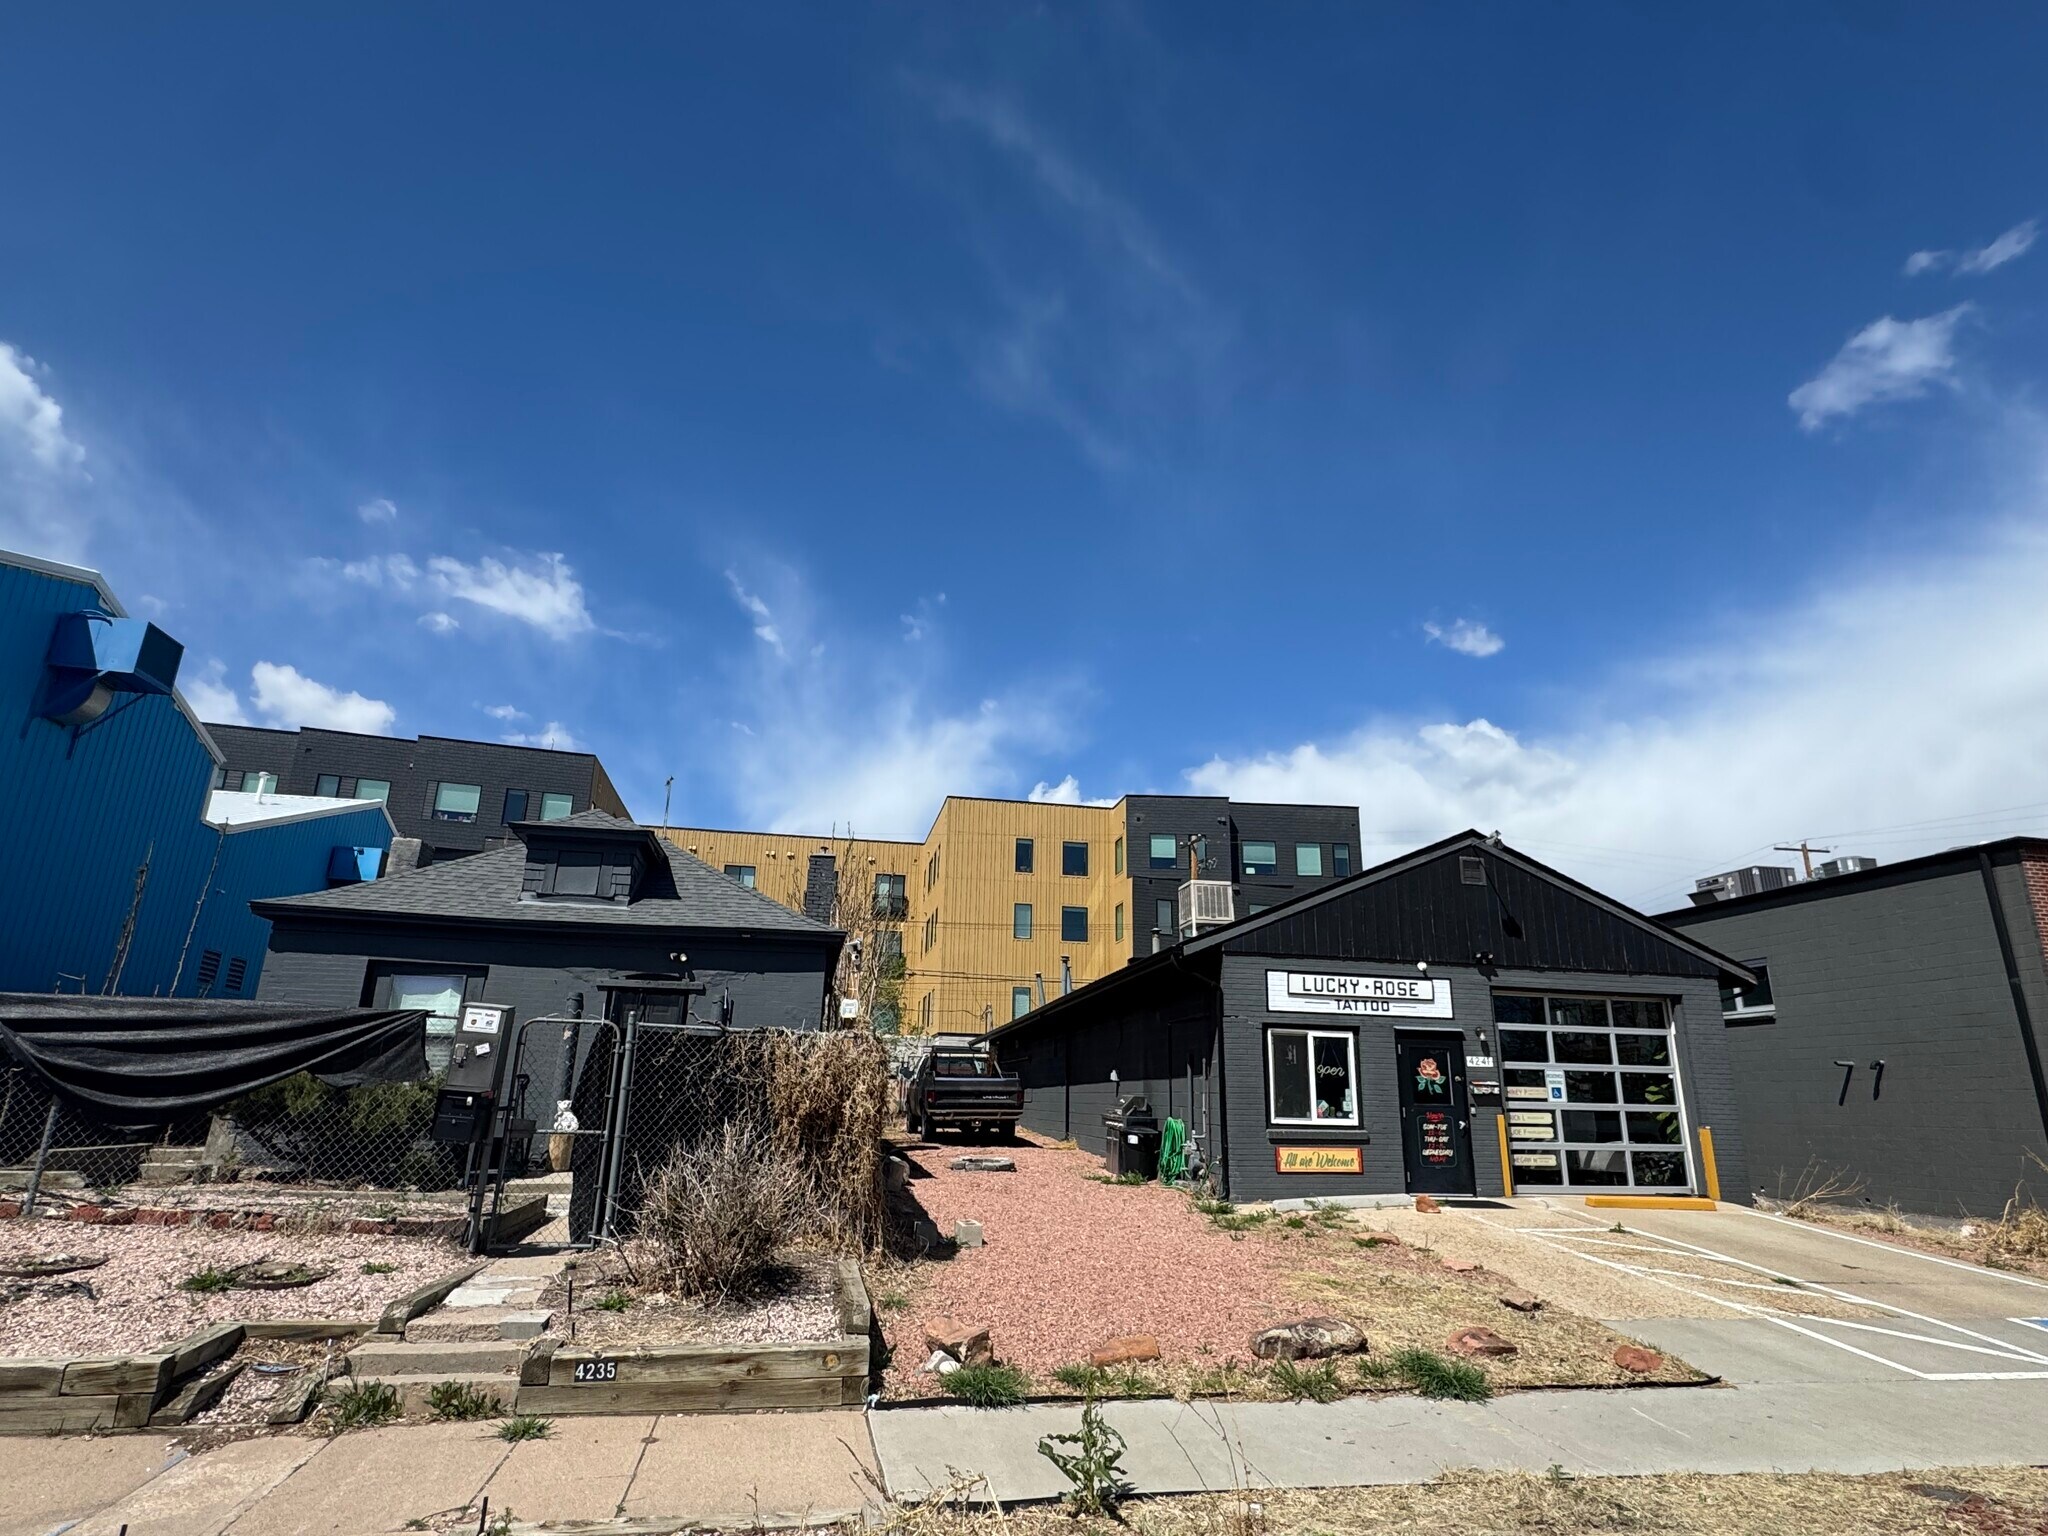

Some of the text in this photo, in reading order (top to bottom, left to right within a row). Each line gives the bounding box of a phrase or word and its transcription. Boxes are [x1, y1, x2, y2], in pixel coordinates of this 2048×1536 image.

[1302, 976, 1420, 997] LUCKY ROSE
[1334, 998, 1390, 1012] TATTOO
[1469, 1057, 1490, 1065] 4241
[1317, 1064, 1345, 1078] open
[1284, 1151, 1355, 1168] All are Welcome
[575, 1362, 616, 1380] 4235
